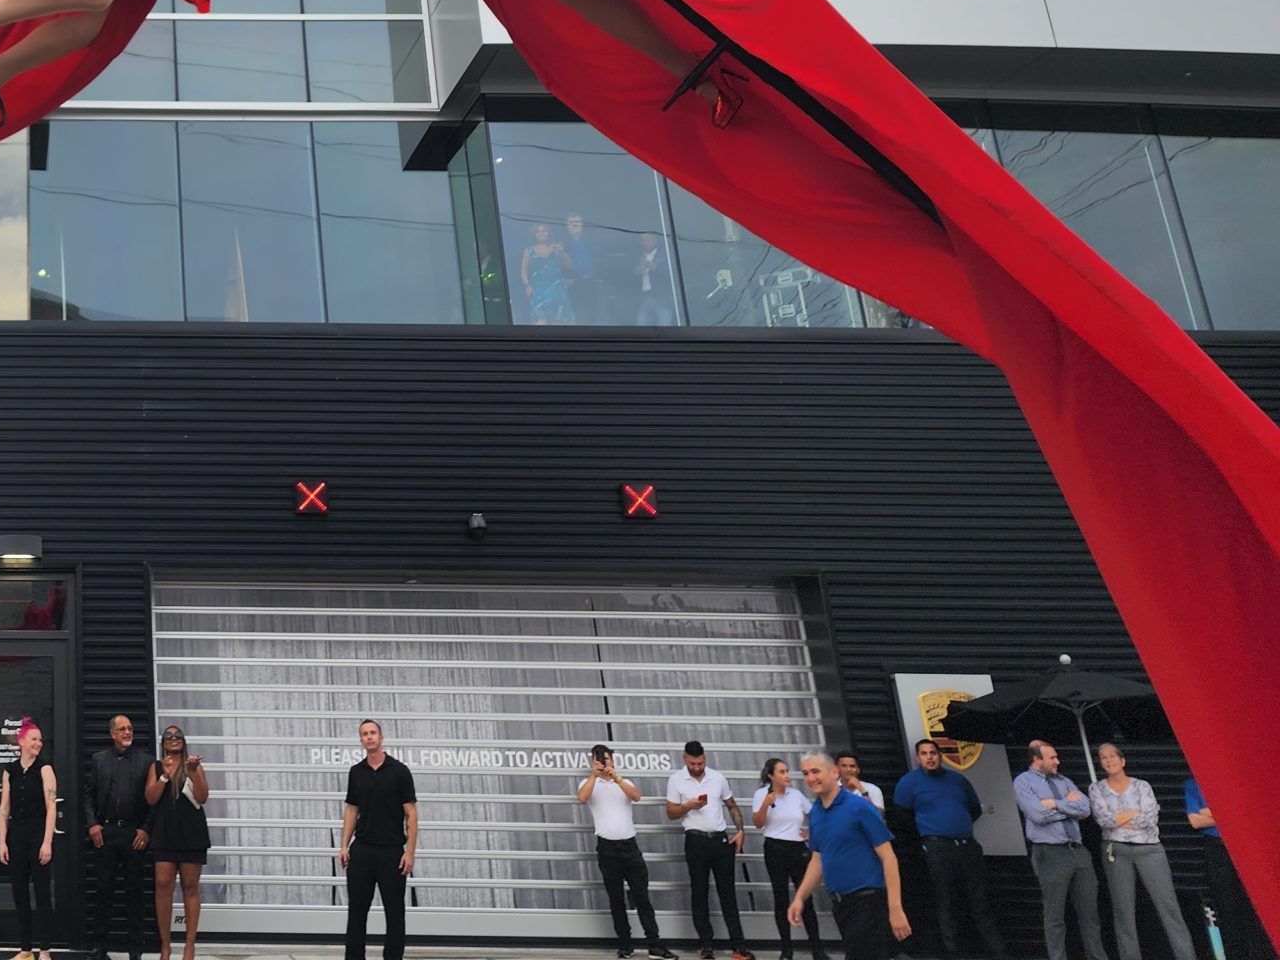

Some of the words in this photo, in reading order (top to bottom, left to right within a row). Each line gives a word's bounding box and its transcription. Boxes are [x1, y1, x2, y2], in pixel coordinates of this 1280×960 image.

[310, 749, 368, 766] PLEAS
[420, 750, 502, 768] FORWARD
[505, 751, 528, 768] TO
[531, 752, 593, 769] ACTIVA
[614, 753, 672, 770] DOORS
